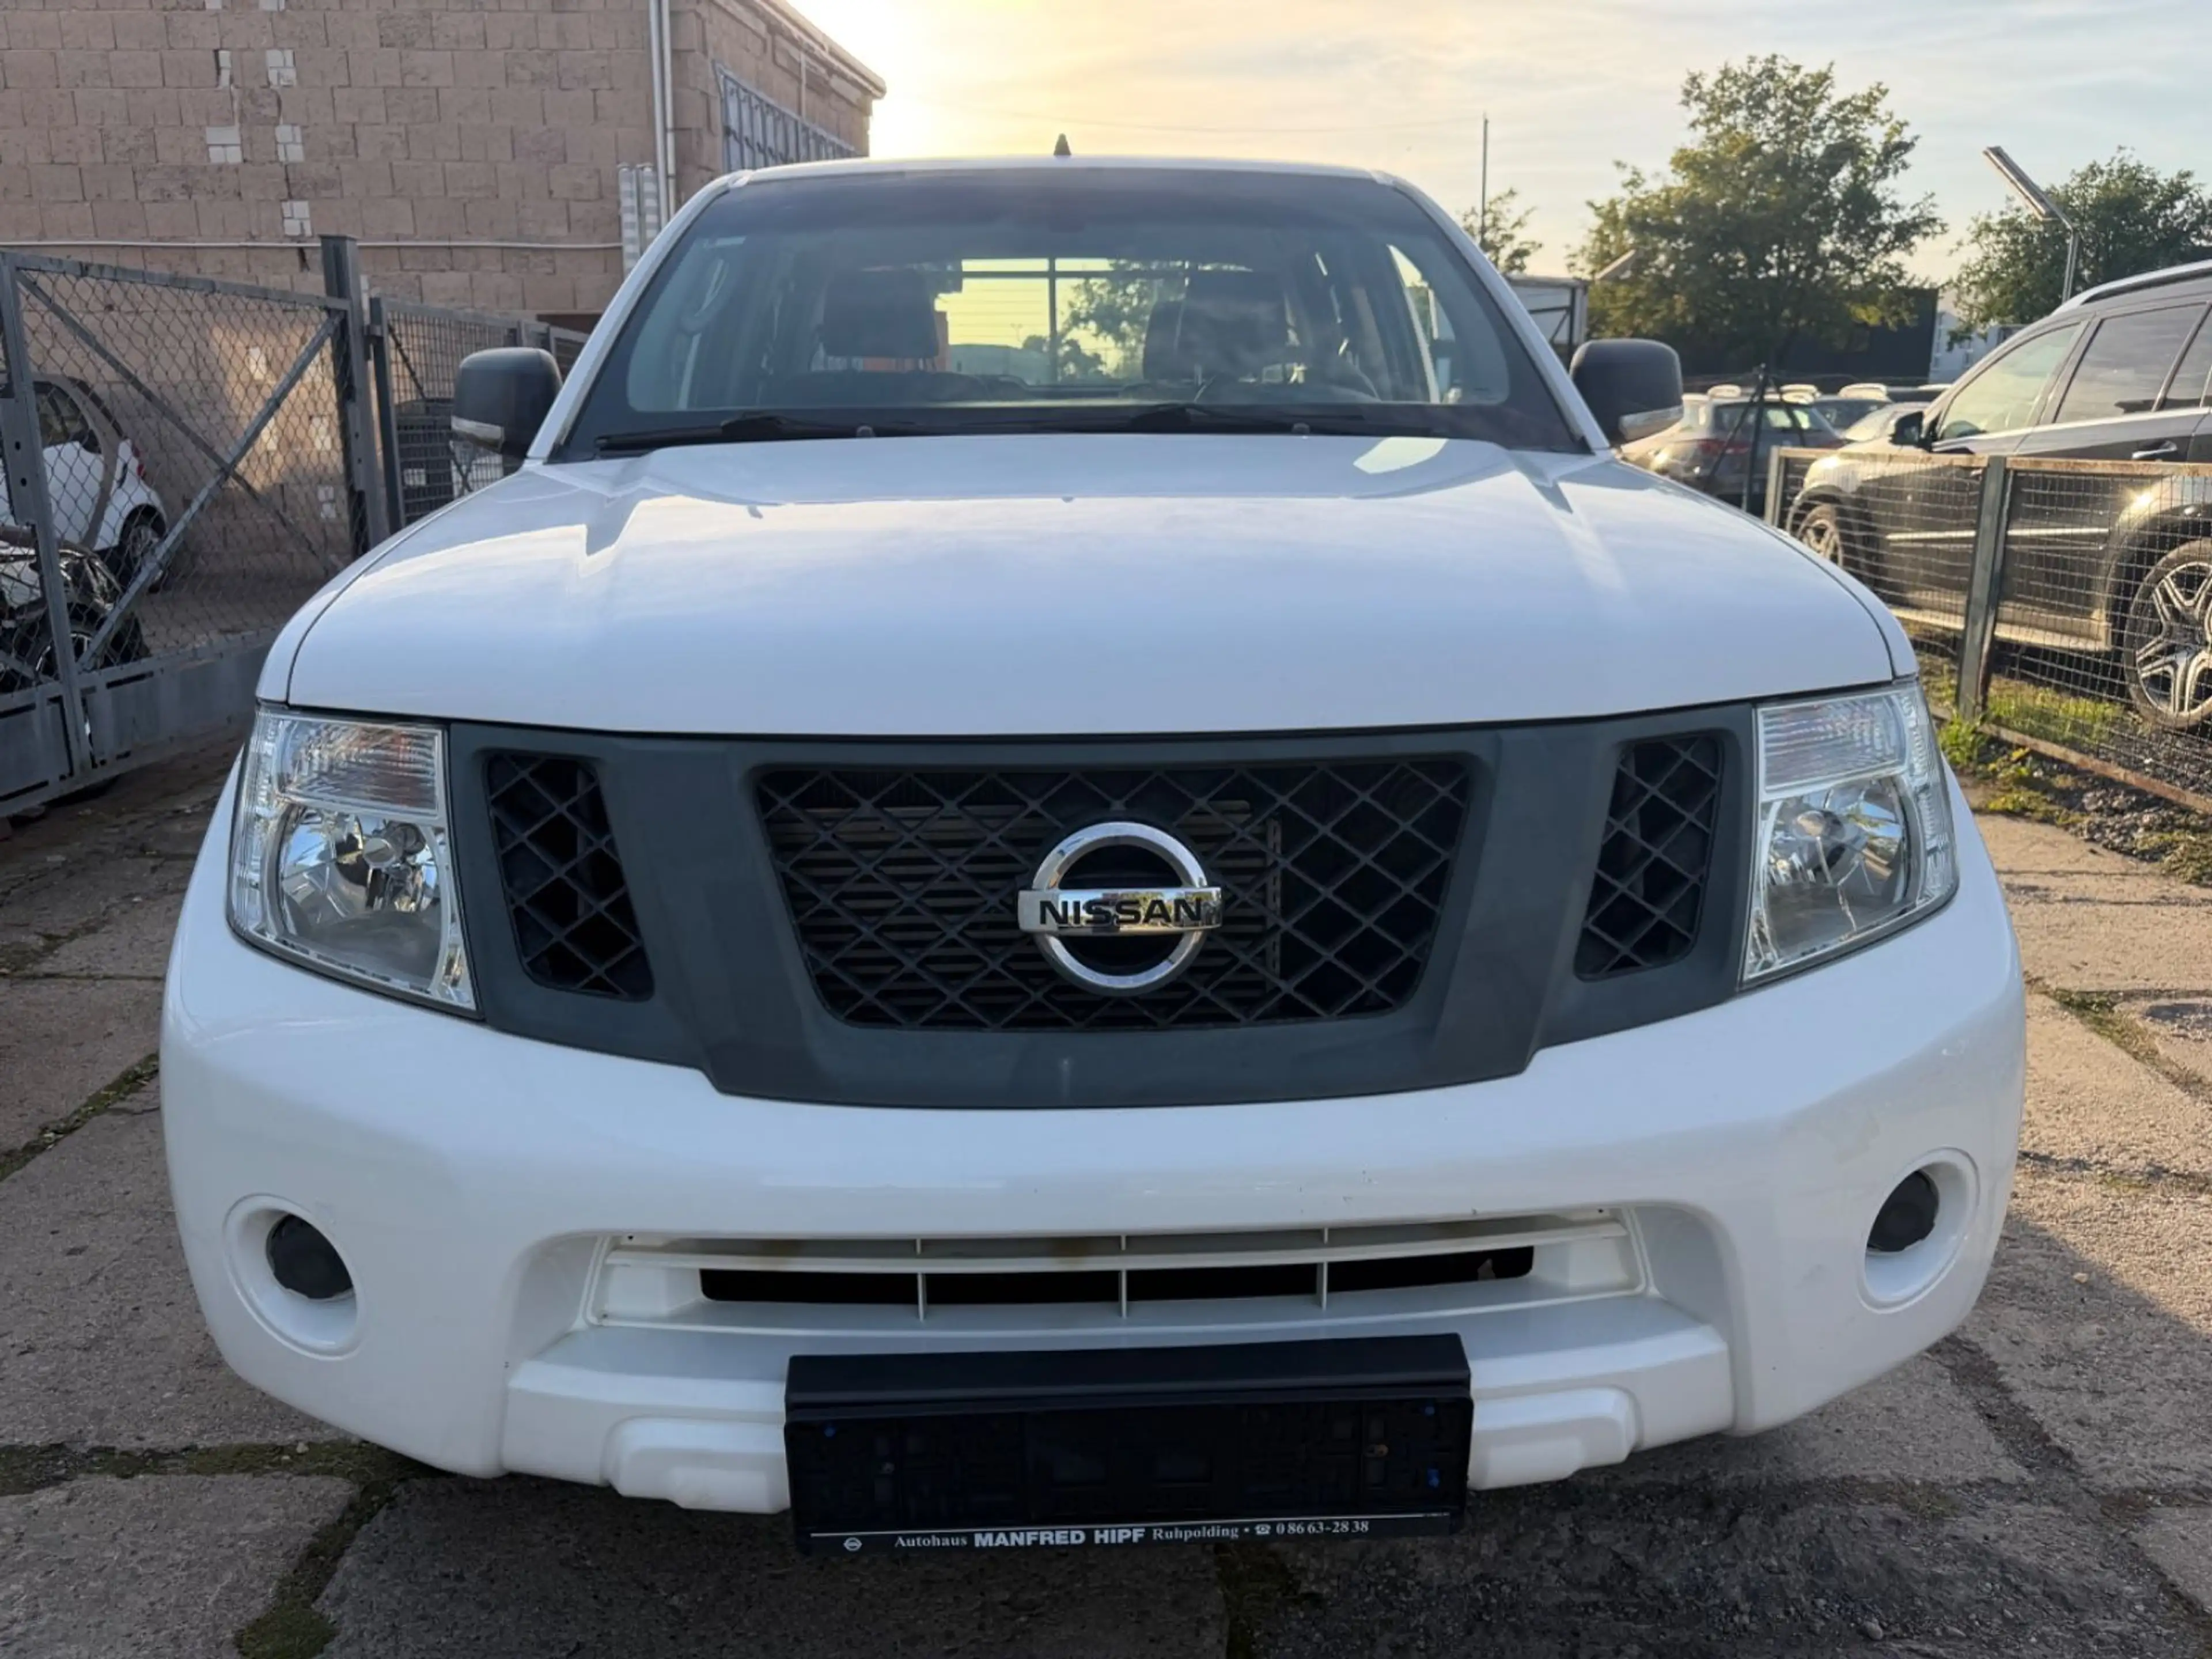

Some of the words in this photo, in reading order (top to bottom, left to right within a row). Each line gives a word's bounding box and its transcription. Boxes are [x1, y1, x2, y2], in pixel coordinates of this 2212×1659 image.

[1039, 897, 1202, 926] NISSAN
[894, 1535, 968, 1548] Autohaus
[974, 1530, 1086, 1547] MANFRED
[1094, 1528, 1146, 1544] HIPF
[1152, 1525, 1240, 1542] Ruhpolding
